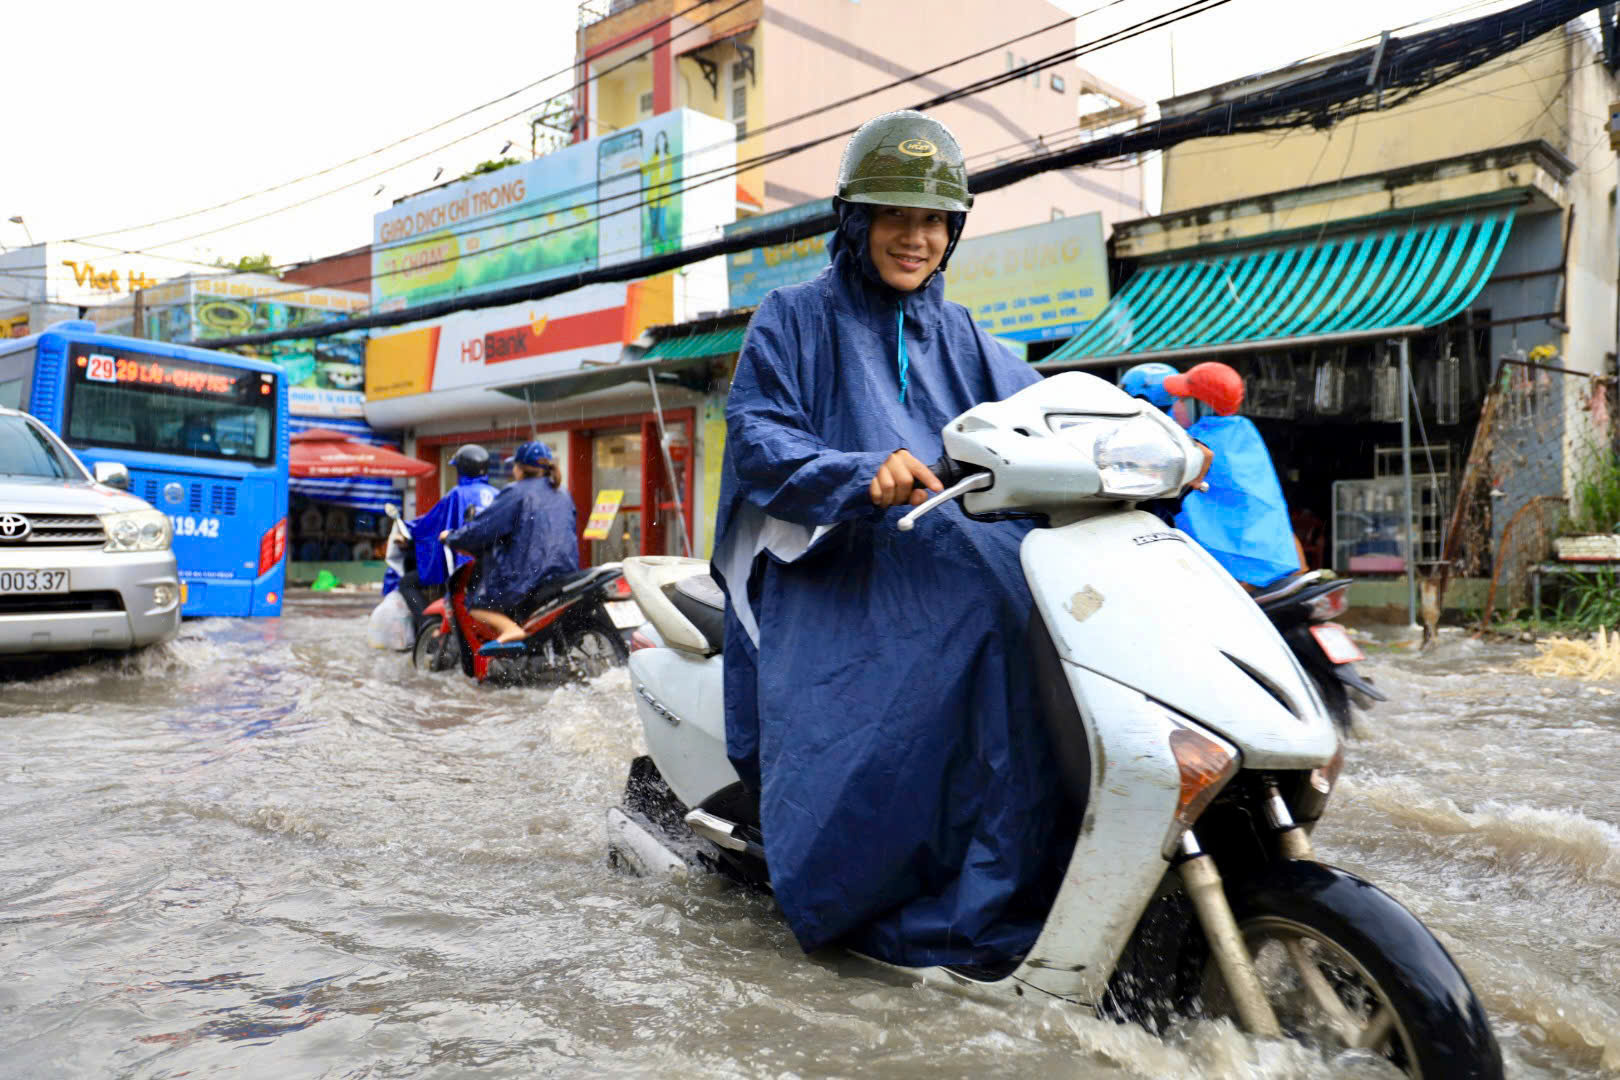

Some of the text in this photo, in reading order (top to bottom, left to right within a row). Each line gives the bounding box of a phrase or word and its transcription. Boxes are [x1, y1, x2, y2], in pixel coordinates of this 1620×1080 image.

[380, 215, 414, 243] GIAO
[473, 179, 526, 215] TRONG
[460, 331, 528, 365] HDBank
[90, 358, 114, 380] 29
[115, 358, 138, 382] 29
[0, 571, 66, 592] 003.37
